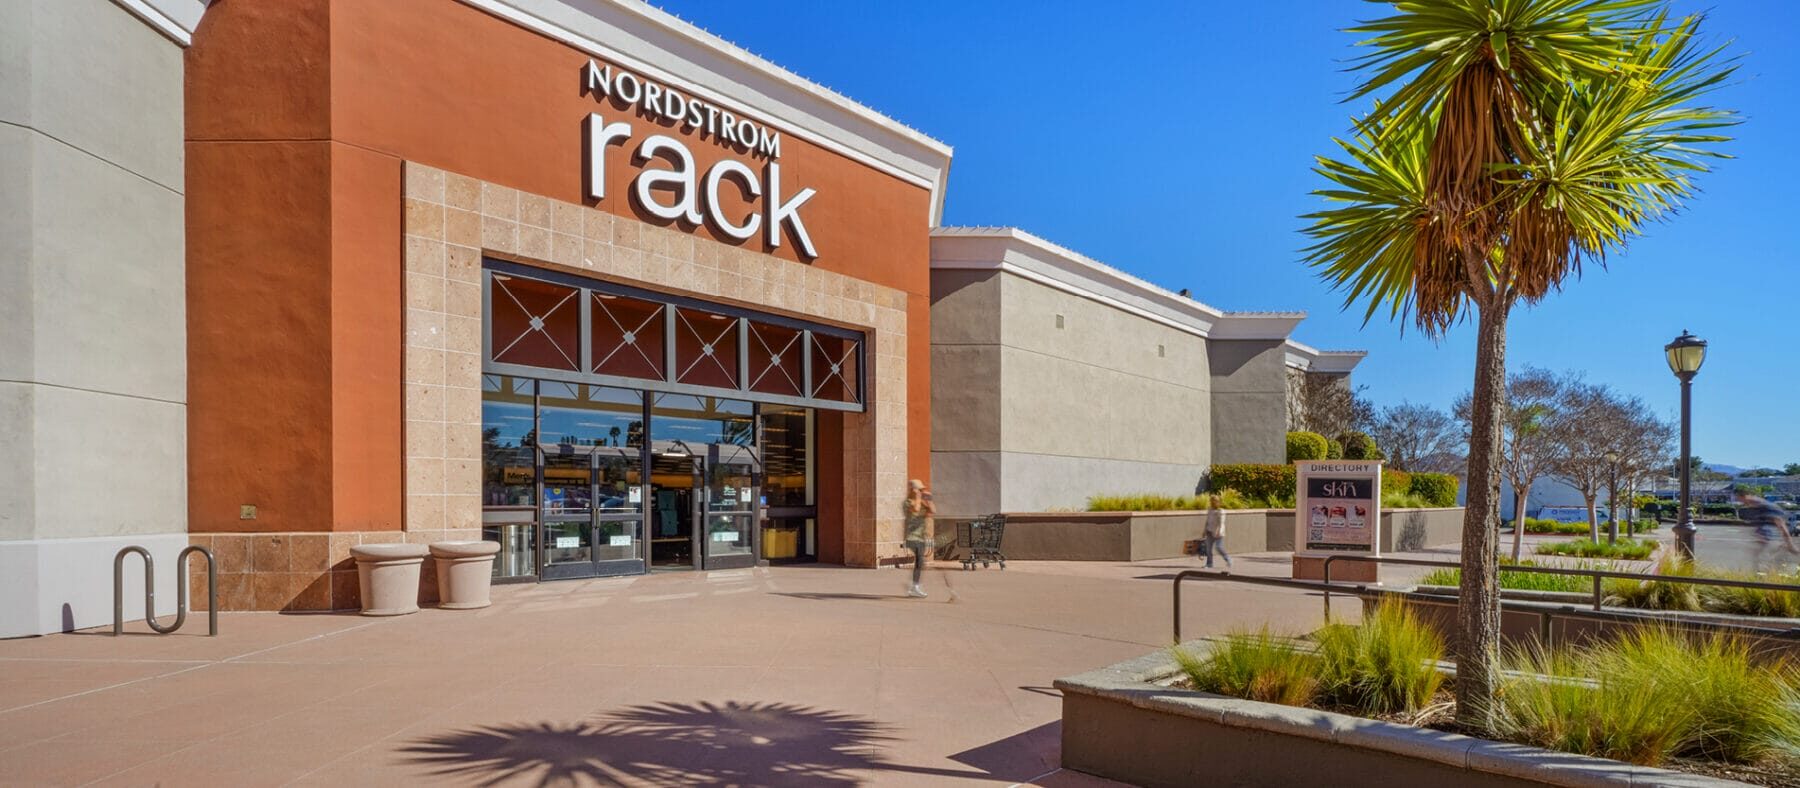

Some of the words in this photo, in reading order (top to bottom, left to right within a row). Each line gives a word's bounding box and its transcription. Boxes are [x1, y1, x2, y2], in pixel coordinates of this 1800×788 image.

[588, 59, 781, 158] NORDSTROM
[589, 112, 818, 258] rack
[1311, 463, 1369, 472] DIRECTORY
